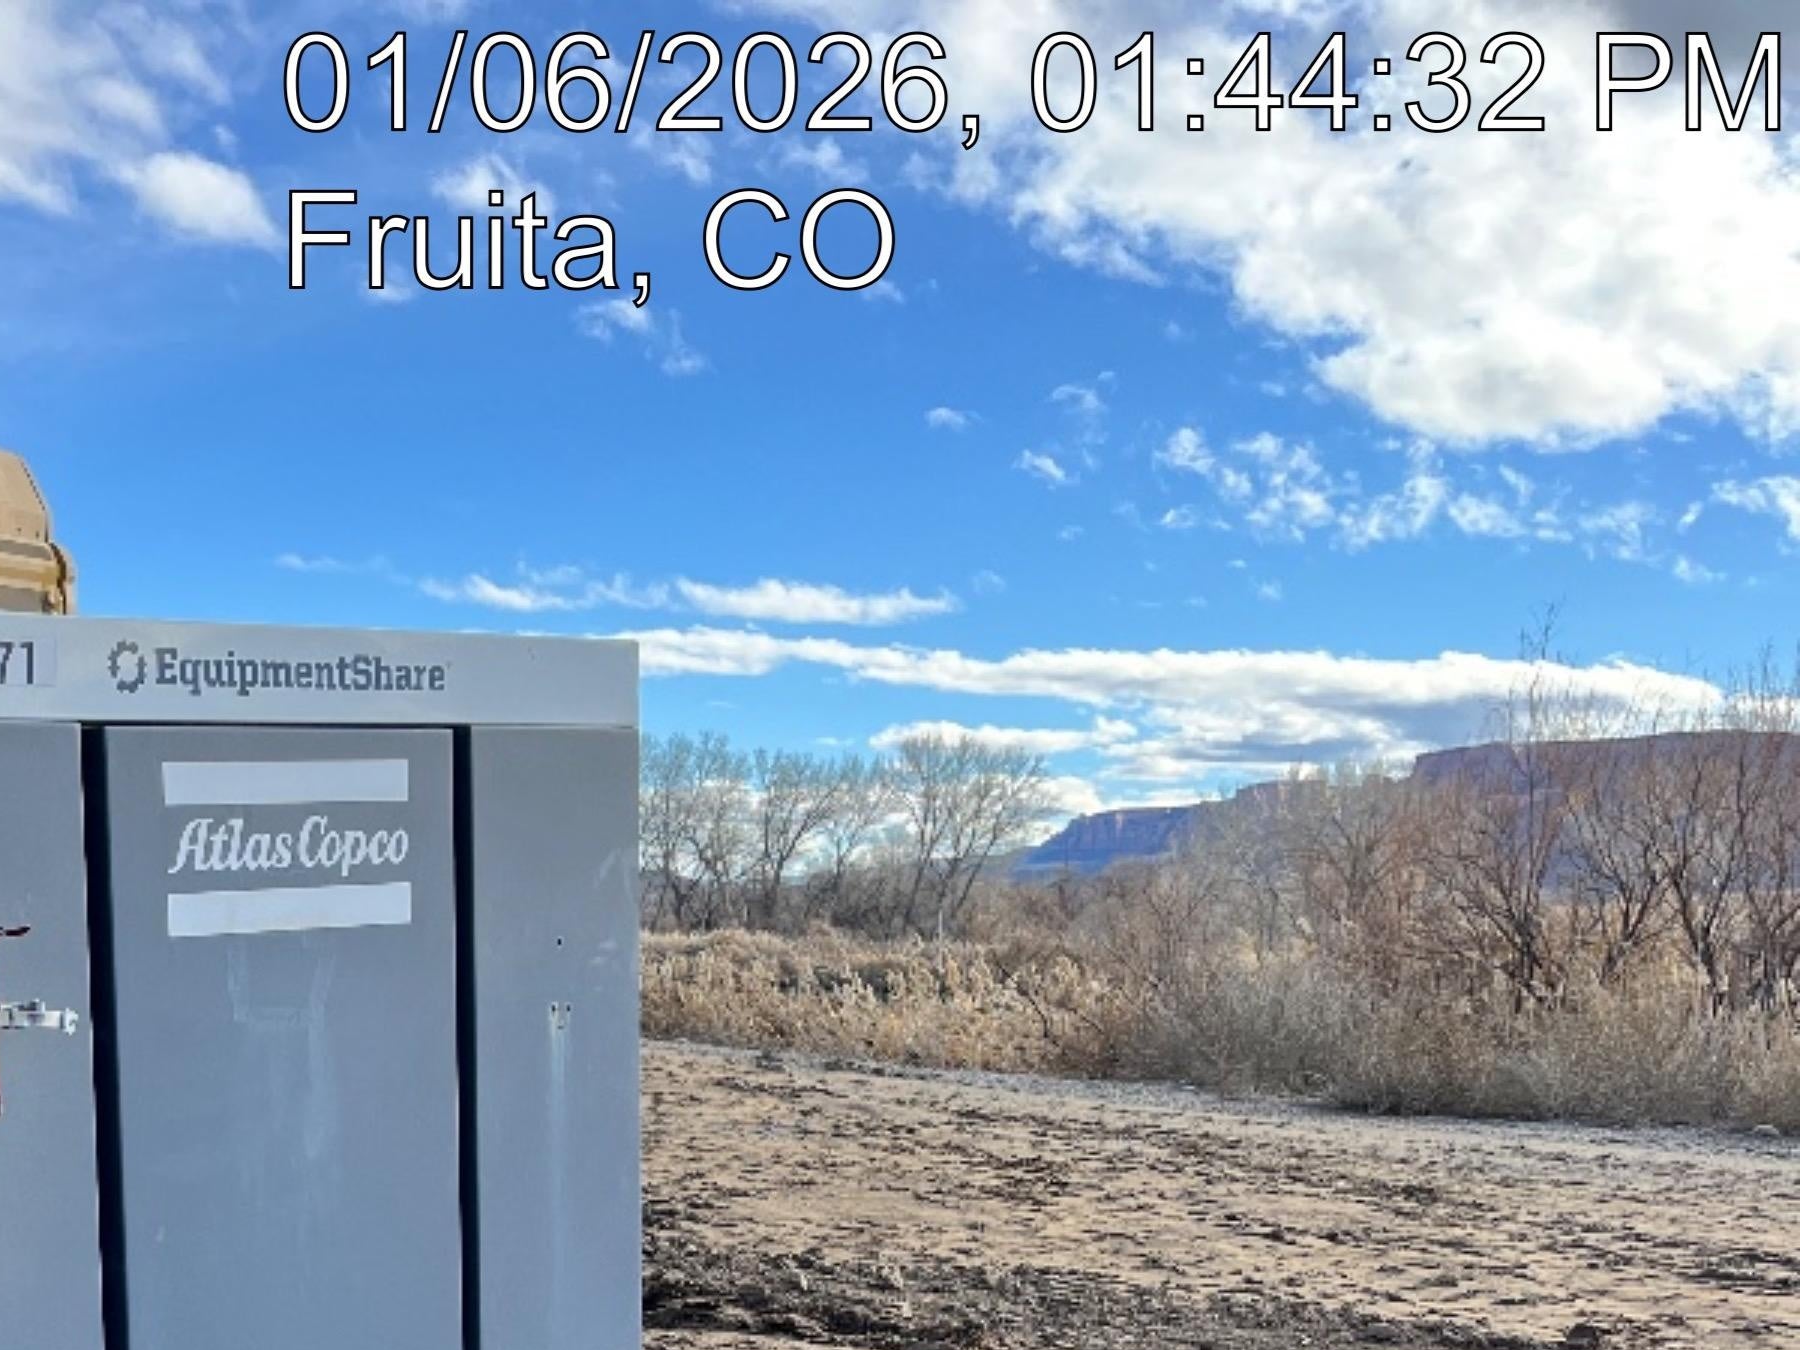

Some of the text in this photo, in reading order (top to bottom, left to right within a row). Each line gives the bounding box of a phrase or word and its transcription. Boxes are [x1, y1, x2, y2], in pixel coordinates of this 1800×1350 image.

[154, 646, 447, 697] EquipmentShare
[167, 814, 409, 877] Atlas Copco
